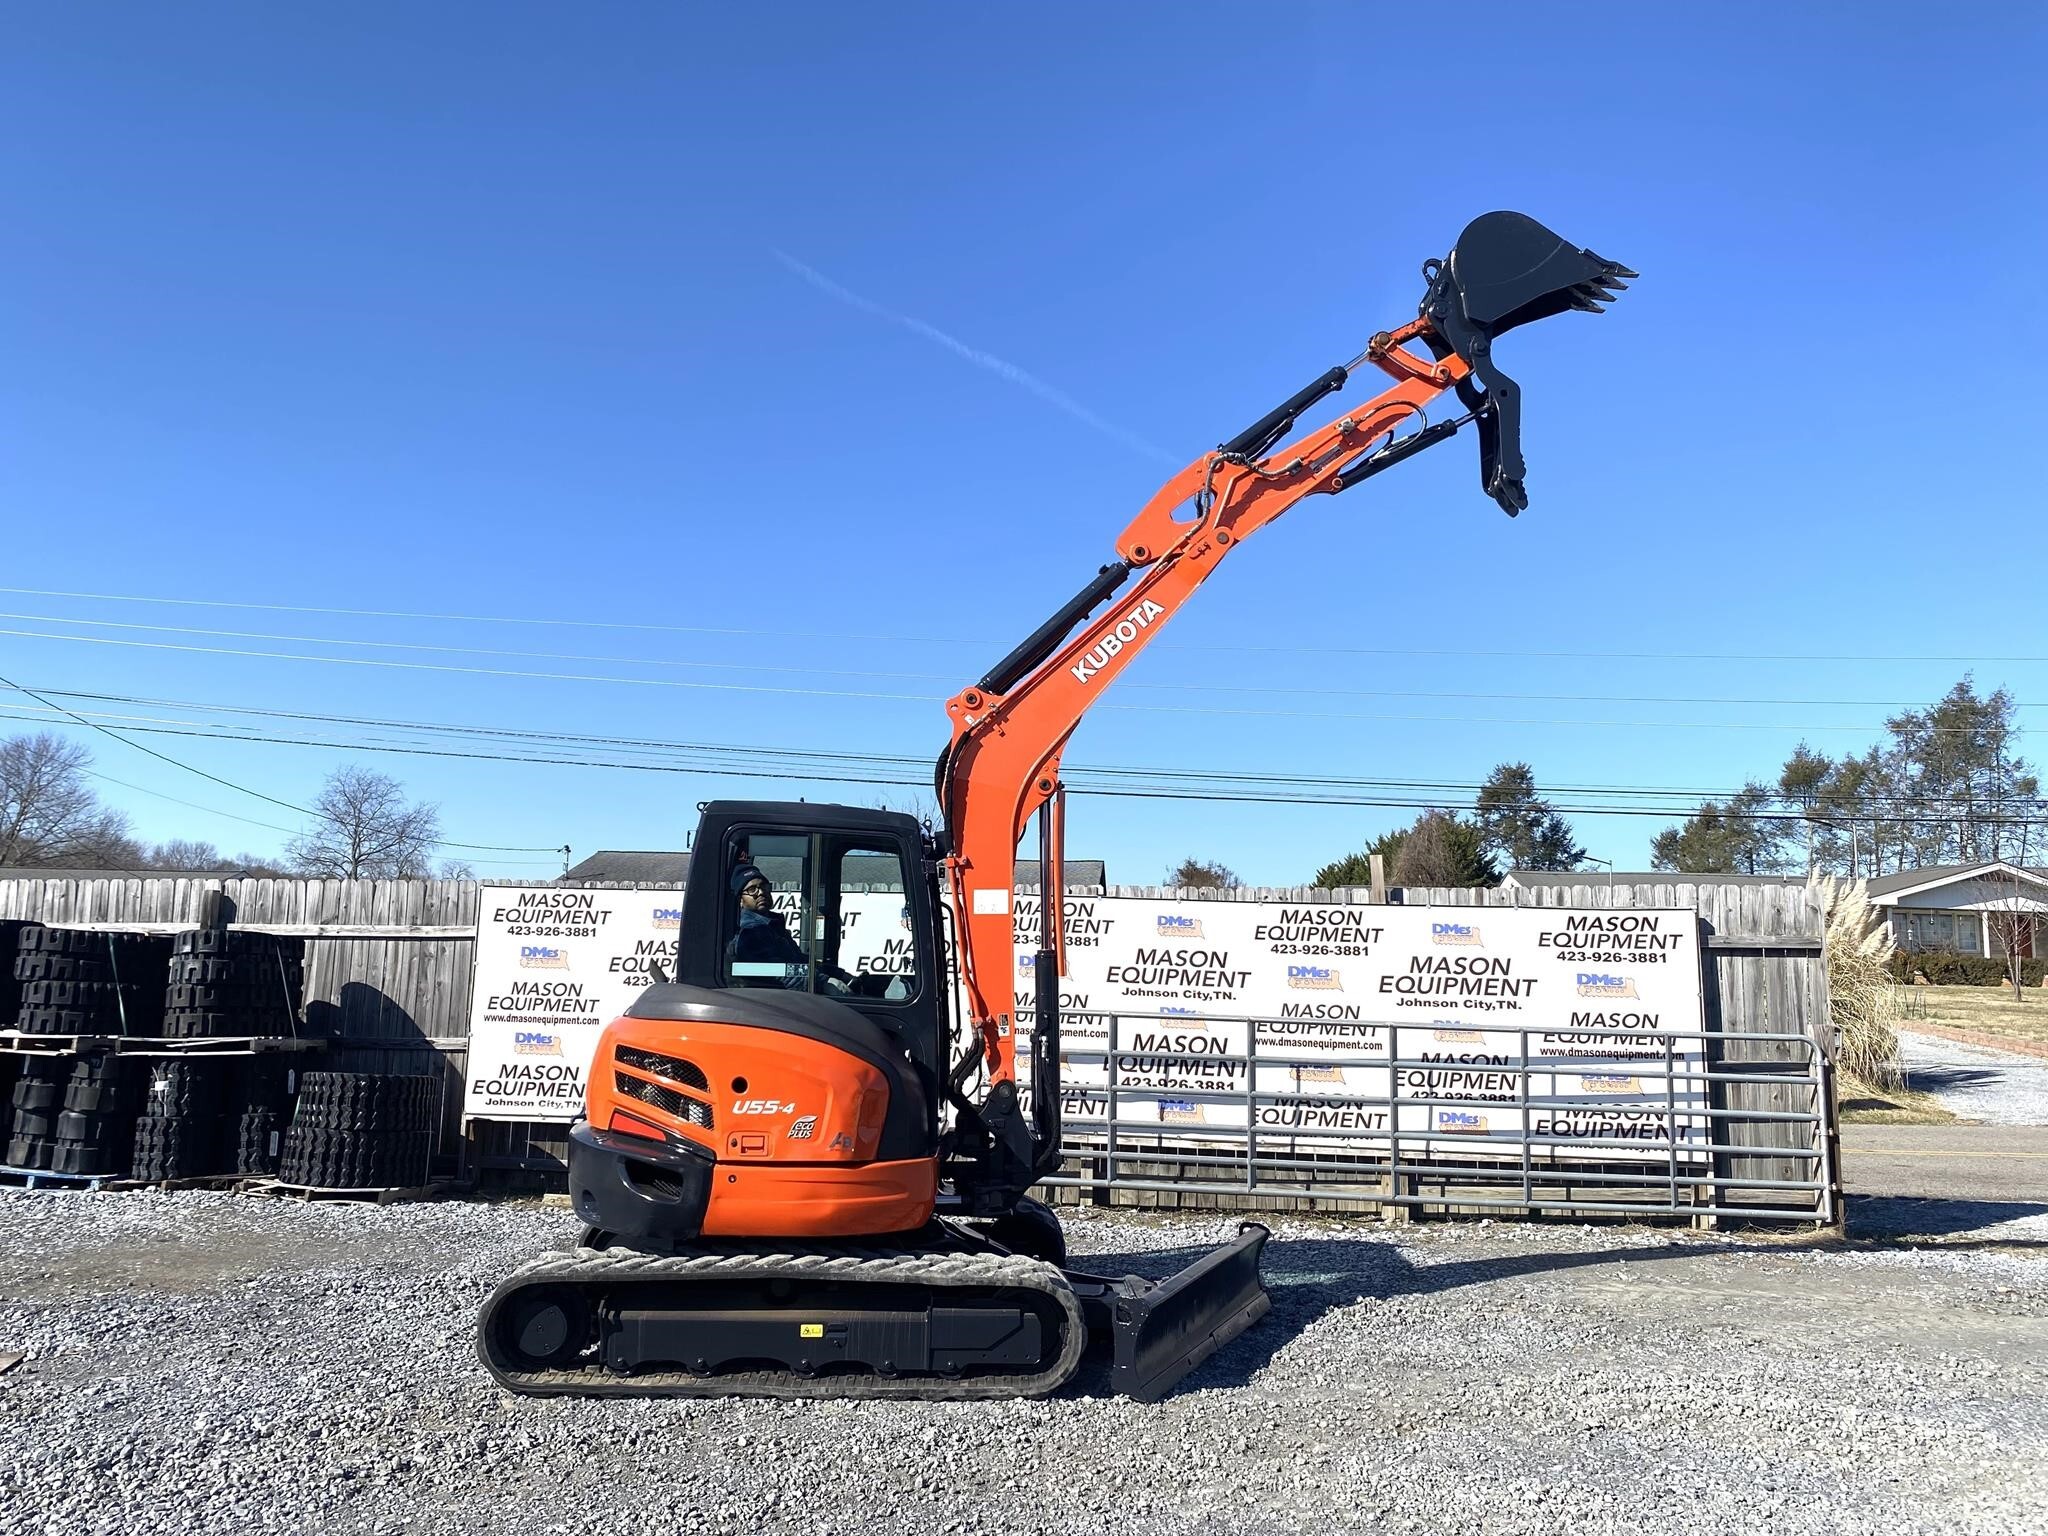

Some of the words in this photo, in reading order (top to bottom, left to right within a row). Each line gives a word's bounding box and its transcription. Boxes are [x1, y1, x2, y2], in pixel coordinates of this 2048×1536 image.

[1070, 599, 1165, 684] KUBOTA
[518, 892, 594, 909] MASON
[493, 908, 613, 925] EQUIPMENT
[1280, 909, 1363, 926] MASON
[1566, 916, 1659, 932] MASON
[507, 926, 597, 938] 423-926-3881
[1254, 925, 1384, 943] EQUIPMENT
[1538, 932, 1683, 949] EQUIPMENT
[634, 940, 679, 956] MAS
[1270, 944, 1369, 956] 423-926-3881
[1135, 948, 1228, 968] MASON
[1556, 951, 1667, 963] 423-926-3881
[1409, 956, 1511, 976] MASON
[1106, 966, 1252, 988] EQUIPMENT
[510, 981, 583, 997] MASON
[1122, 988, 1178, 998] Johnson
[1183, 990, 1237, 1001] City,TN.
[1378, 975, 1538, 997] EQUIPMENT
[487, 997, 600, 1013] EQUIPMENT
[1281, 1003, 1361, 1020] MASON
[1396, 998, 1458, 1008] Johnson
[1463, 999, 1522, 1011] City,TN.
[484, 1014, 600, 1026] www.dmasonequipment.com
[1570, 1012, 1659, 1029] MASON
[1133, 1033, 1228, 1055] MASON
[1254, 1037, 1383, 1051] www.dmasonequipment.com
[1421, 1052, 1509, 1066] MASON
[499, 1064, 580, 1081] MASON
[472, 1080, 586, 1098] EQUIPMEN
[485, 1098, 535, 1107] Johnson
[732, 1100, 796, 1115] U55-4
[1255, 1108, 1388, 1129] EQUIPMENT
[787, 1130, 813, 1139] PLUS
[1535, 1119, 1692, 1141] EQUIPMENT
